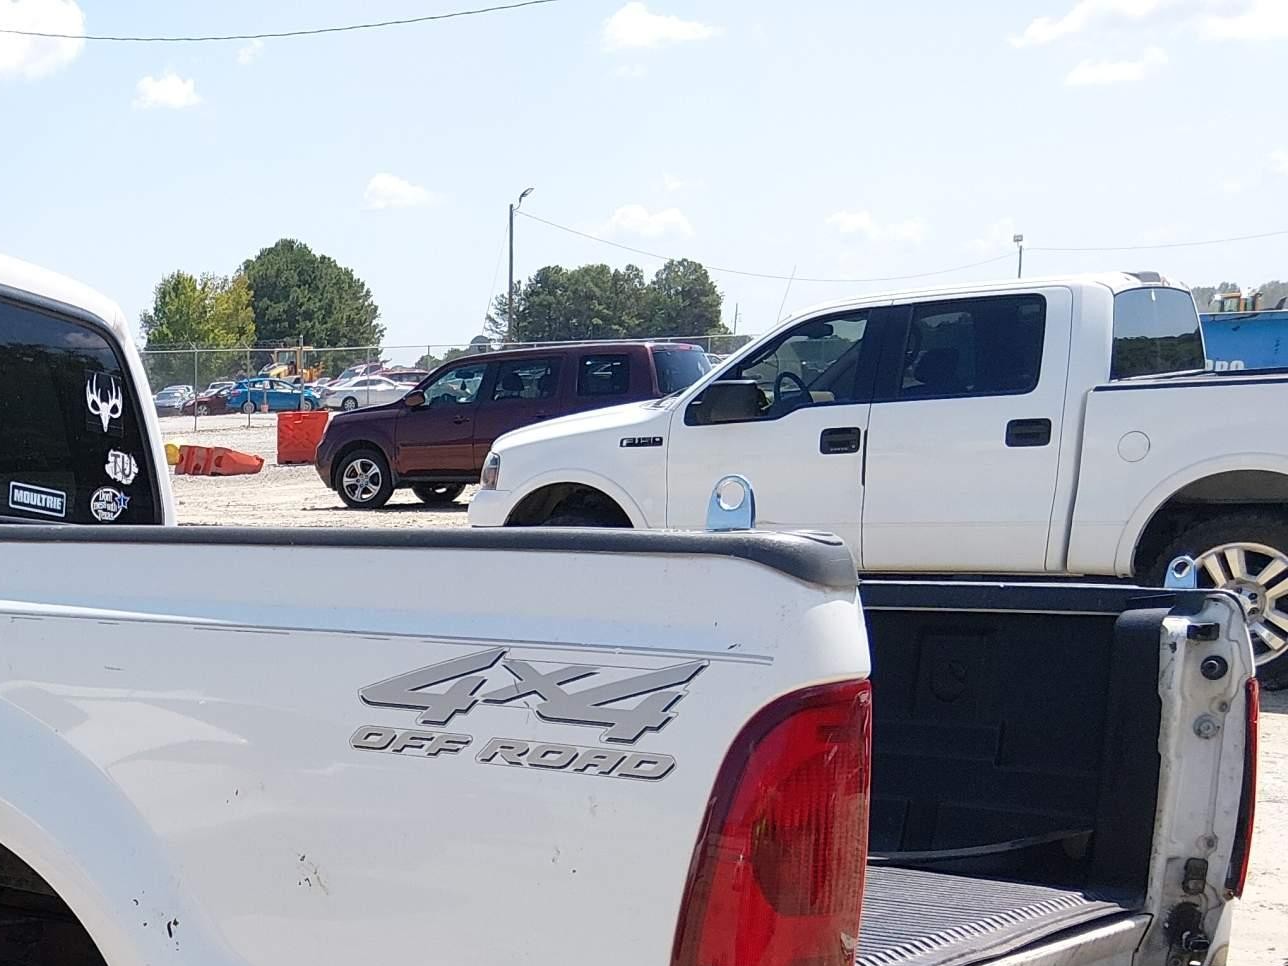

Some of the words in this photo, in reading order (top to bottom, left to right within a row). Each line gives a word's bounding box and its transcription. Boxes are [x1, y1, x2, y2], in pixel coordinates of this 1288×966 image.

[13, 489, 63, 510] MOULTRIE
[350, 727, 472, 757] OFF
[476, 738, 677, 781] ROAD
